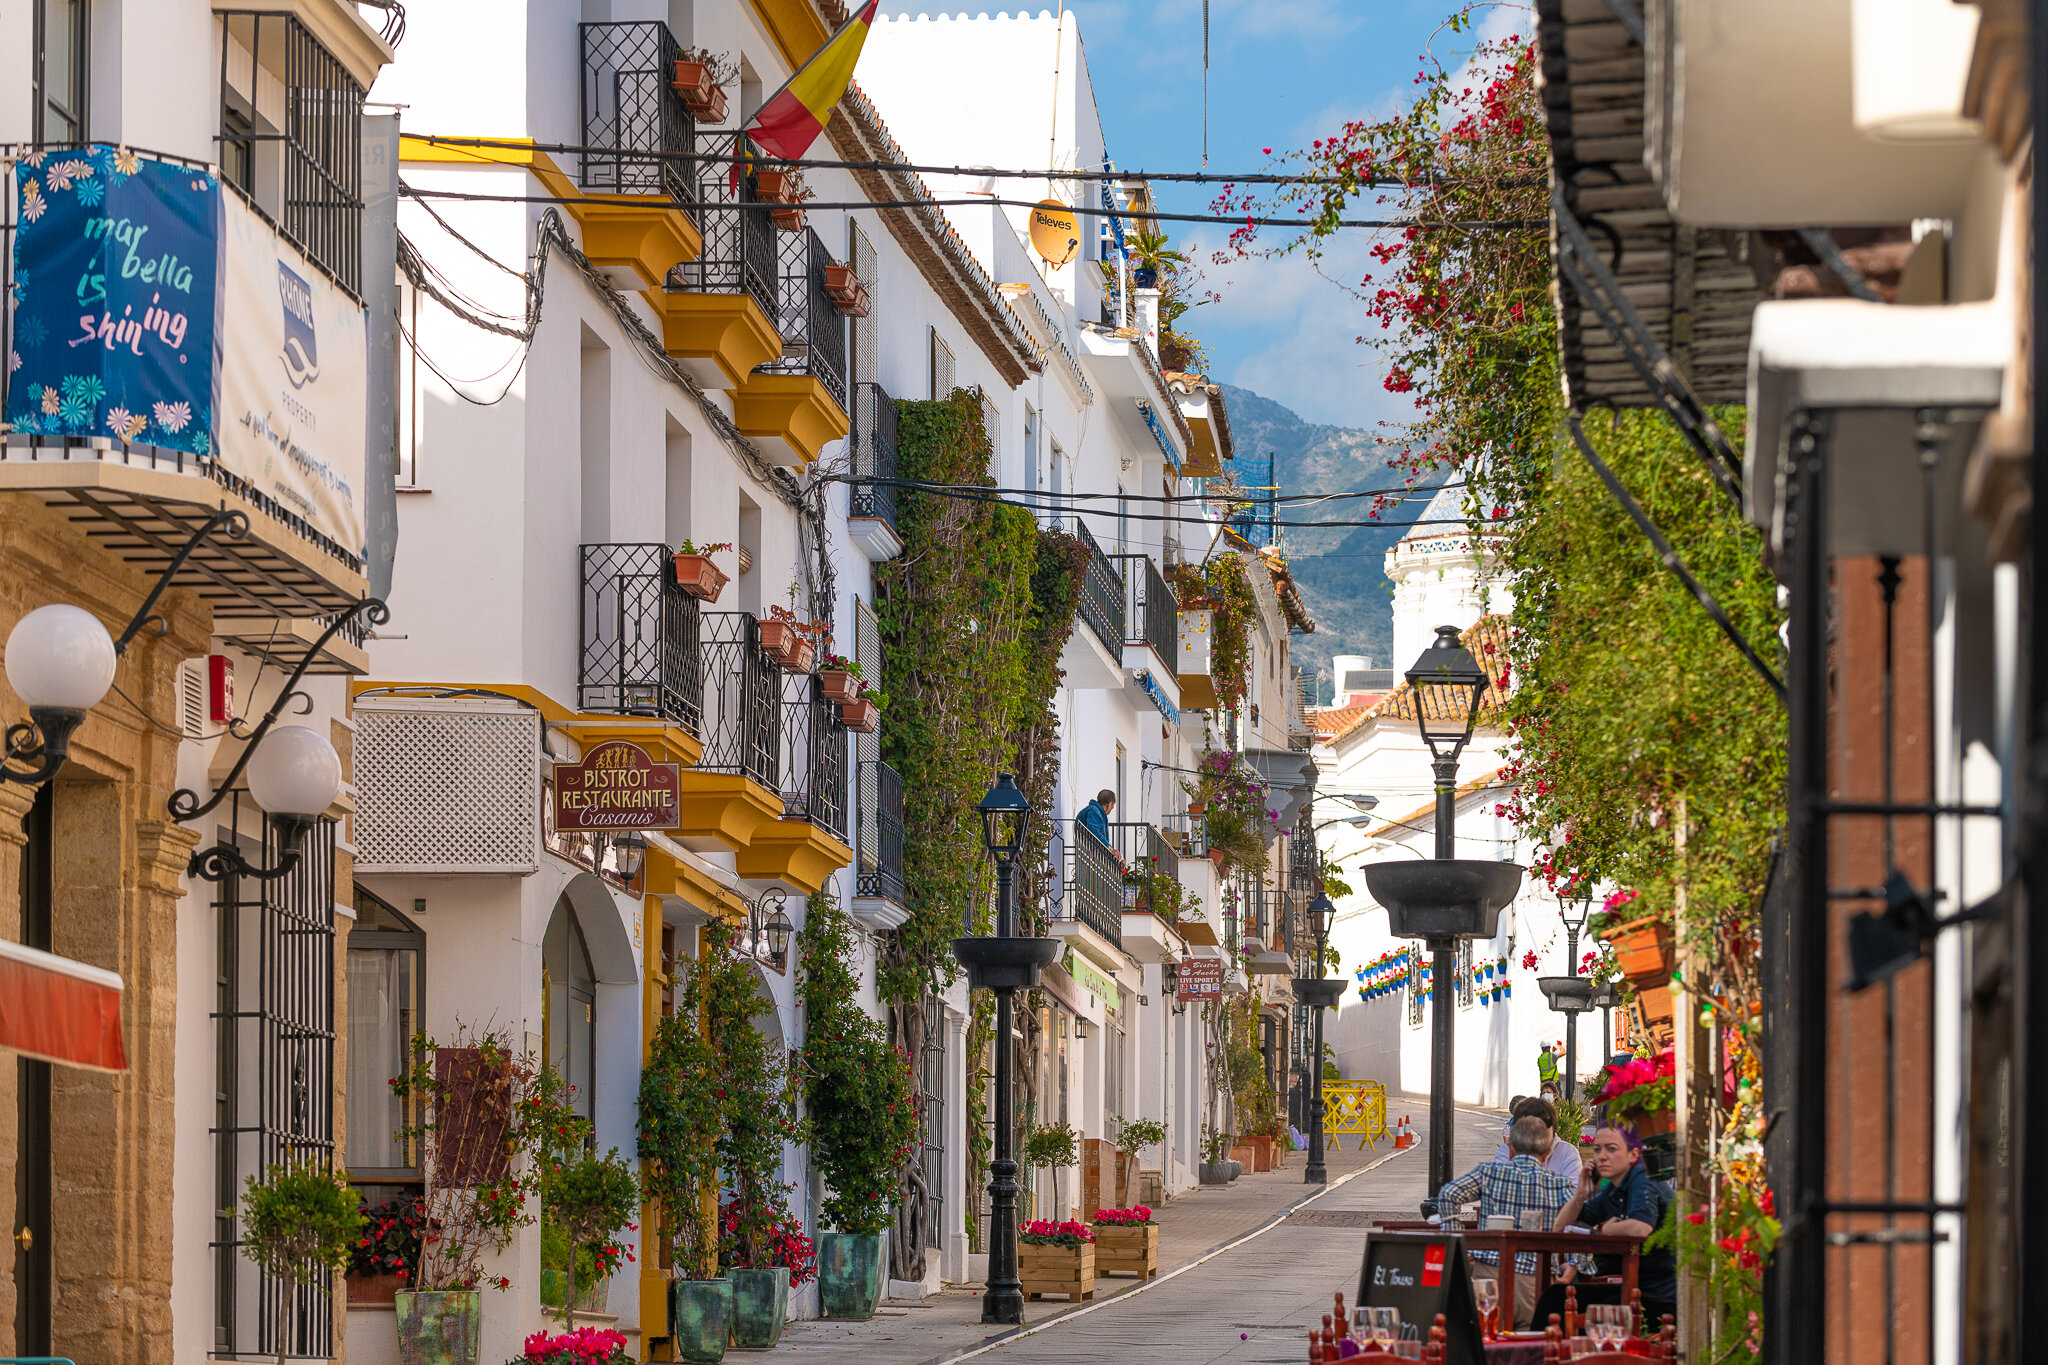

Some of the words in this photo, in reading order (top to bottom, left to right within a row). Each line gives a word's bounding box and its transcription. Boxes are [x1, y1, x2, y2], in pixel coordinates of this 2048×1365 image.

[1036, 212, 1071, 230] Televes
[76, 257, 107, 308] is
[282, 391, 317, 432] PROPERTY
[584, 769, 651, 787] BISTROT
[562, 789, 673, 809] RESTAURANTE
[579, 803, 657, 826] Casanis
